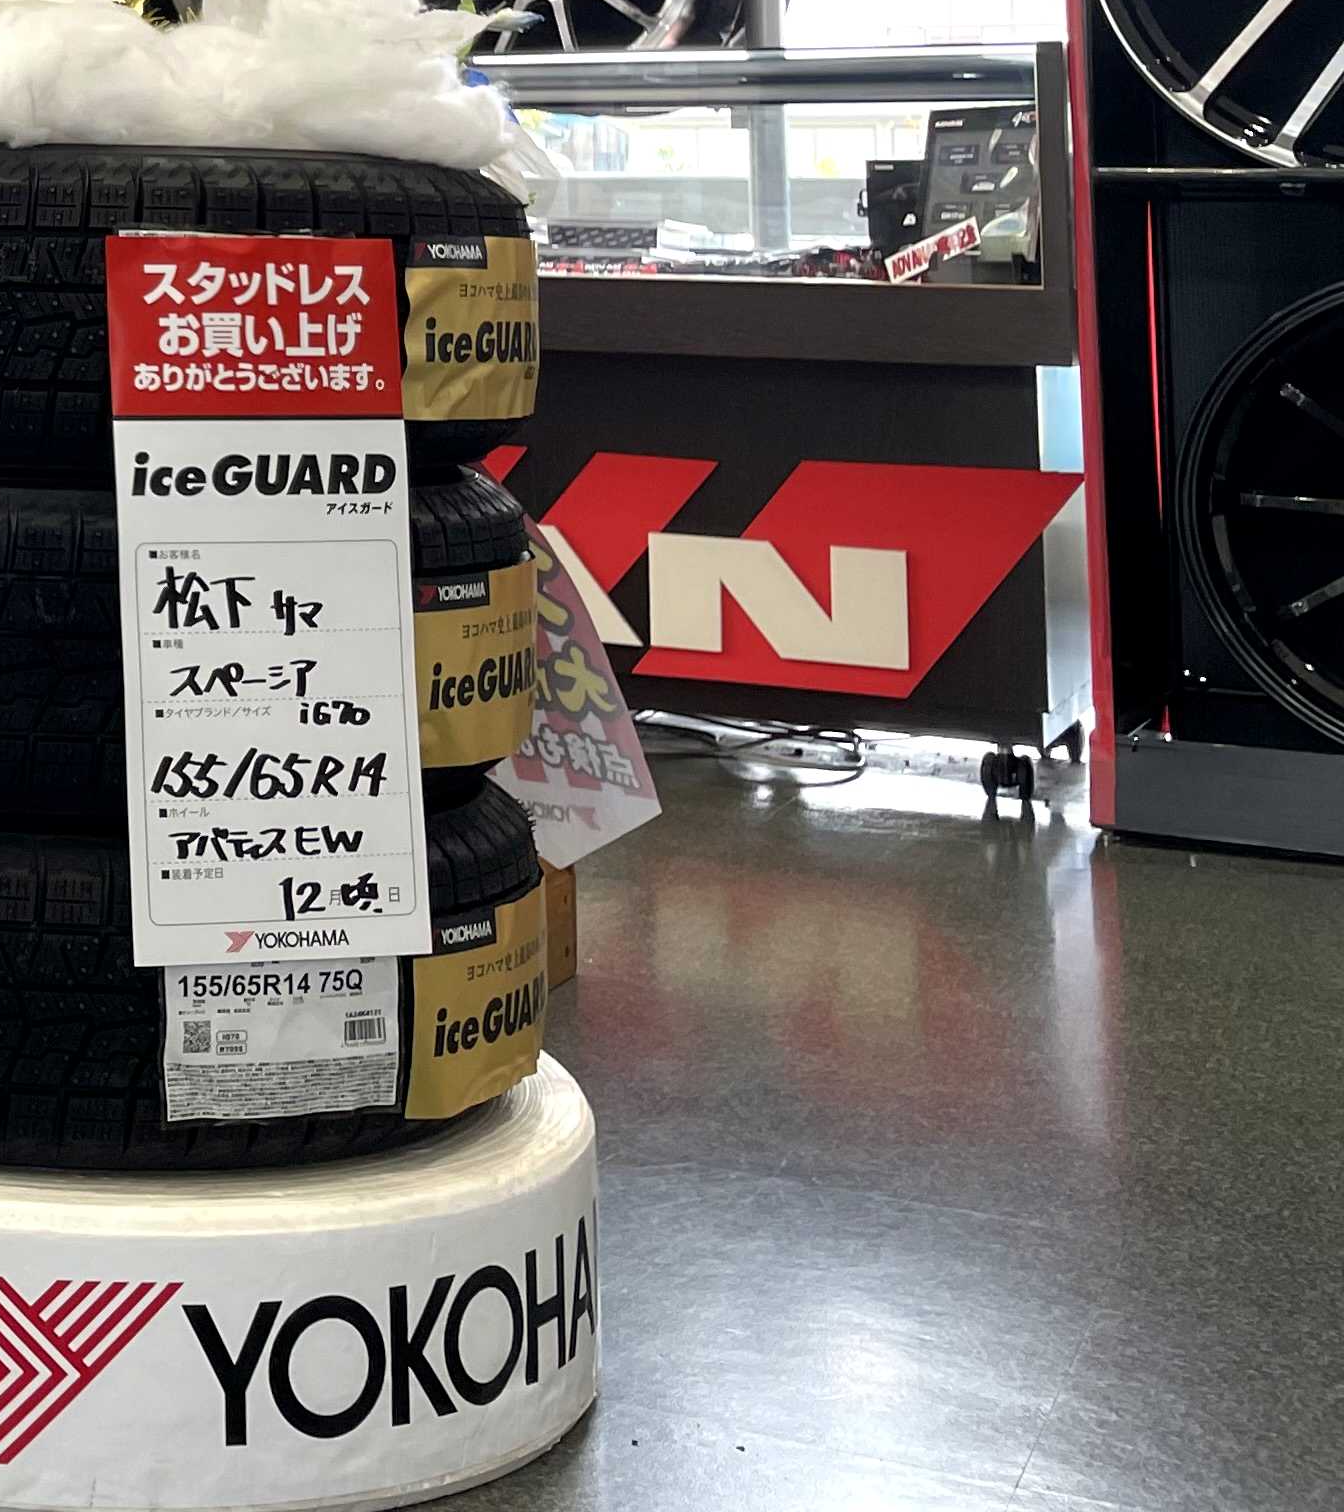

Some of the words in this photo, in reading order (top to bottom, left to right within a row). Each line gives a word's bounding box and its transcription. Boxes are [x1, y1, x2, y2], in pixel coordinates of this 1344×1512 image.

[427, 242, 483, 261] YOKOHAMA
[143, 262, 370, 306] スタッドレス
[158, 312, 363, 357] お買い上げ
[133, 363, 385, 392] ありがとうございます。
[131, 451, 397, 497] iceGUARD
[326, 501, 393, 516] アイスガード
[152, 566, 256, 631] 松下
[437, 581, 487, 602] YOKOHAMA
[162, 638, 184, 650] 車種
[169, 660, 318, 698] スペーシア
[169, 806, 211, 818] ホイール
[171, 867, 225, 881] 装着予定日
[388, 886, 401, 903] 日
[255, 929, 350, 949] YOKOHAMA
[441, 919, 493, 945] YOKOHAMA
[177, 971, 311, 998] 155/65R14
[318, 969, 364, 994] 75Q
[183, 1199, 598, 1448] YOKOHA
